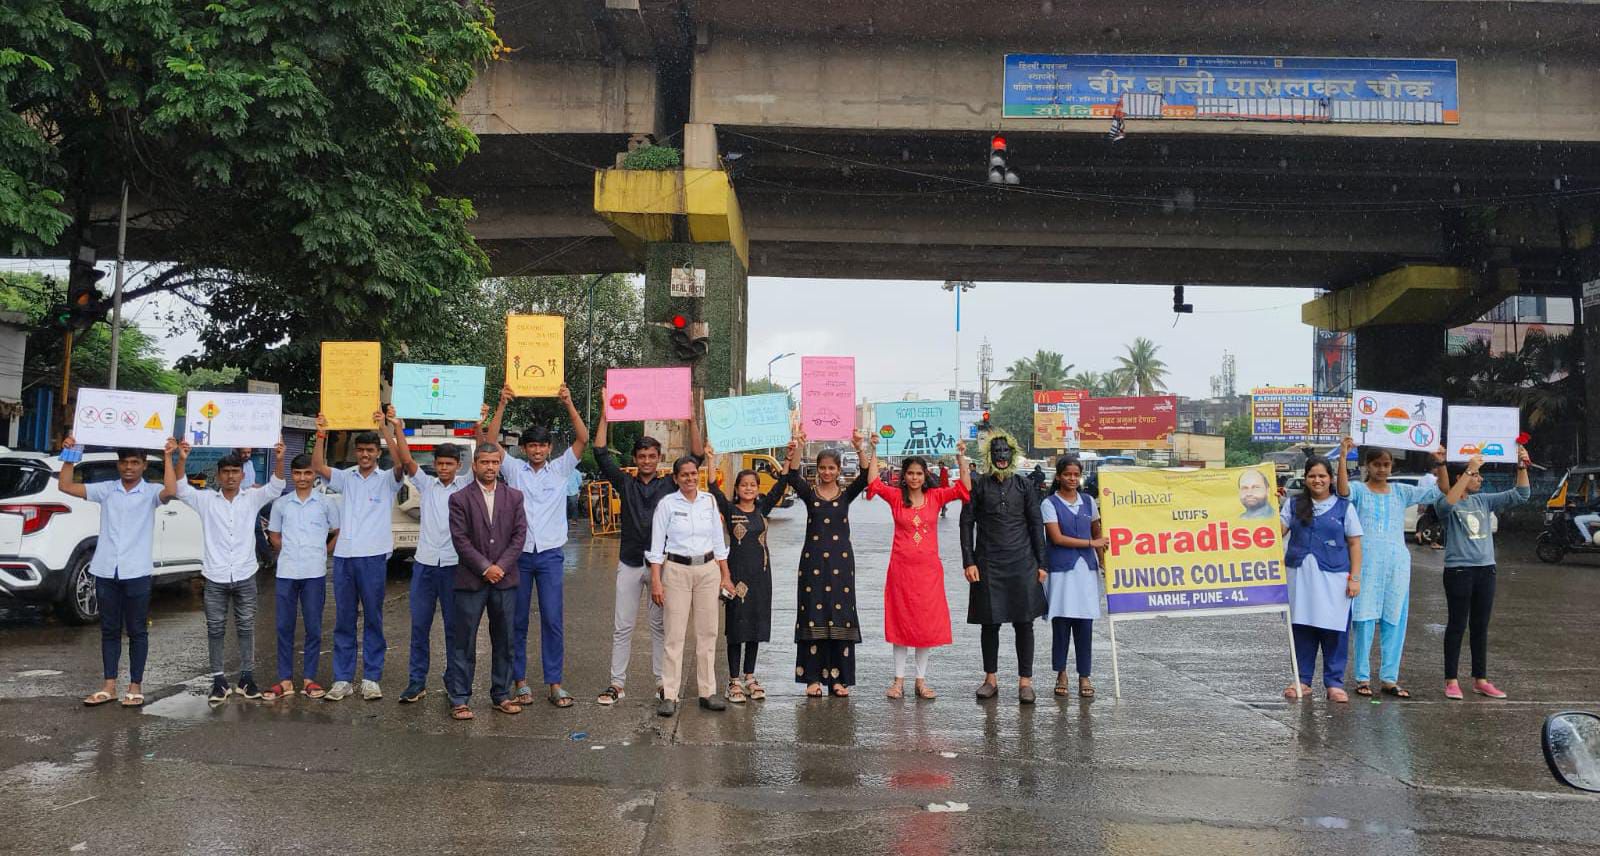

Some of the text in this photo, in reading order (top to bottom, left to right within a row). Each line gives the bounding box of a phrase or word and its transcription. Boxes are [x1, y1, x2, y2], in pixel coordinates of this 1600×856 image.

[1088, 69, 1136, 94] वीर
[1225, 78, 1357, 98] पासलकर
[1366, 73, 1435, 99] चौक
[1112, 489, 1173, 507] Jadhavar
[1172, 509, 1209, 521] LUTJF'S
[1109, 521, 1276, 557] Paradise
[1112, 560, 1281, 590] JUNIOR COLLEGE
[1148, 592, 1191, 608] NARHE,
[1193, 591, 1223, 605] PUNE
[1231, 589, 1249, 603] 41.
